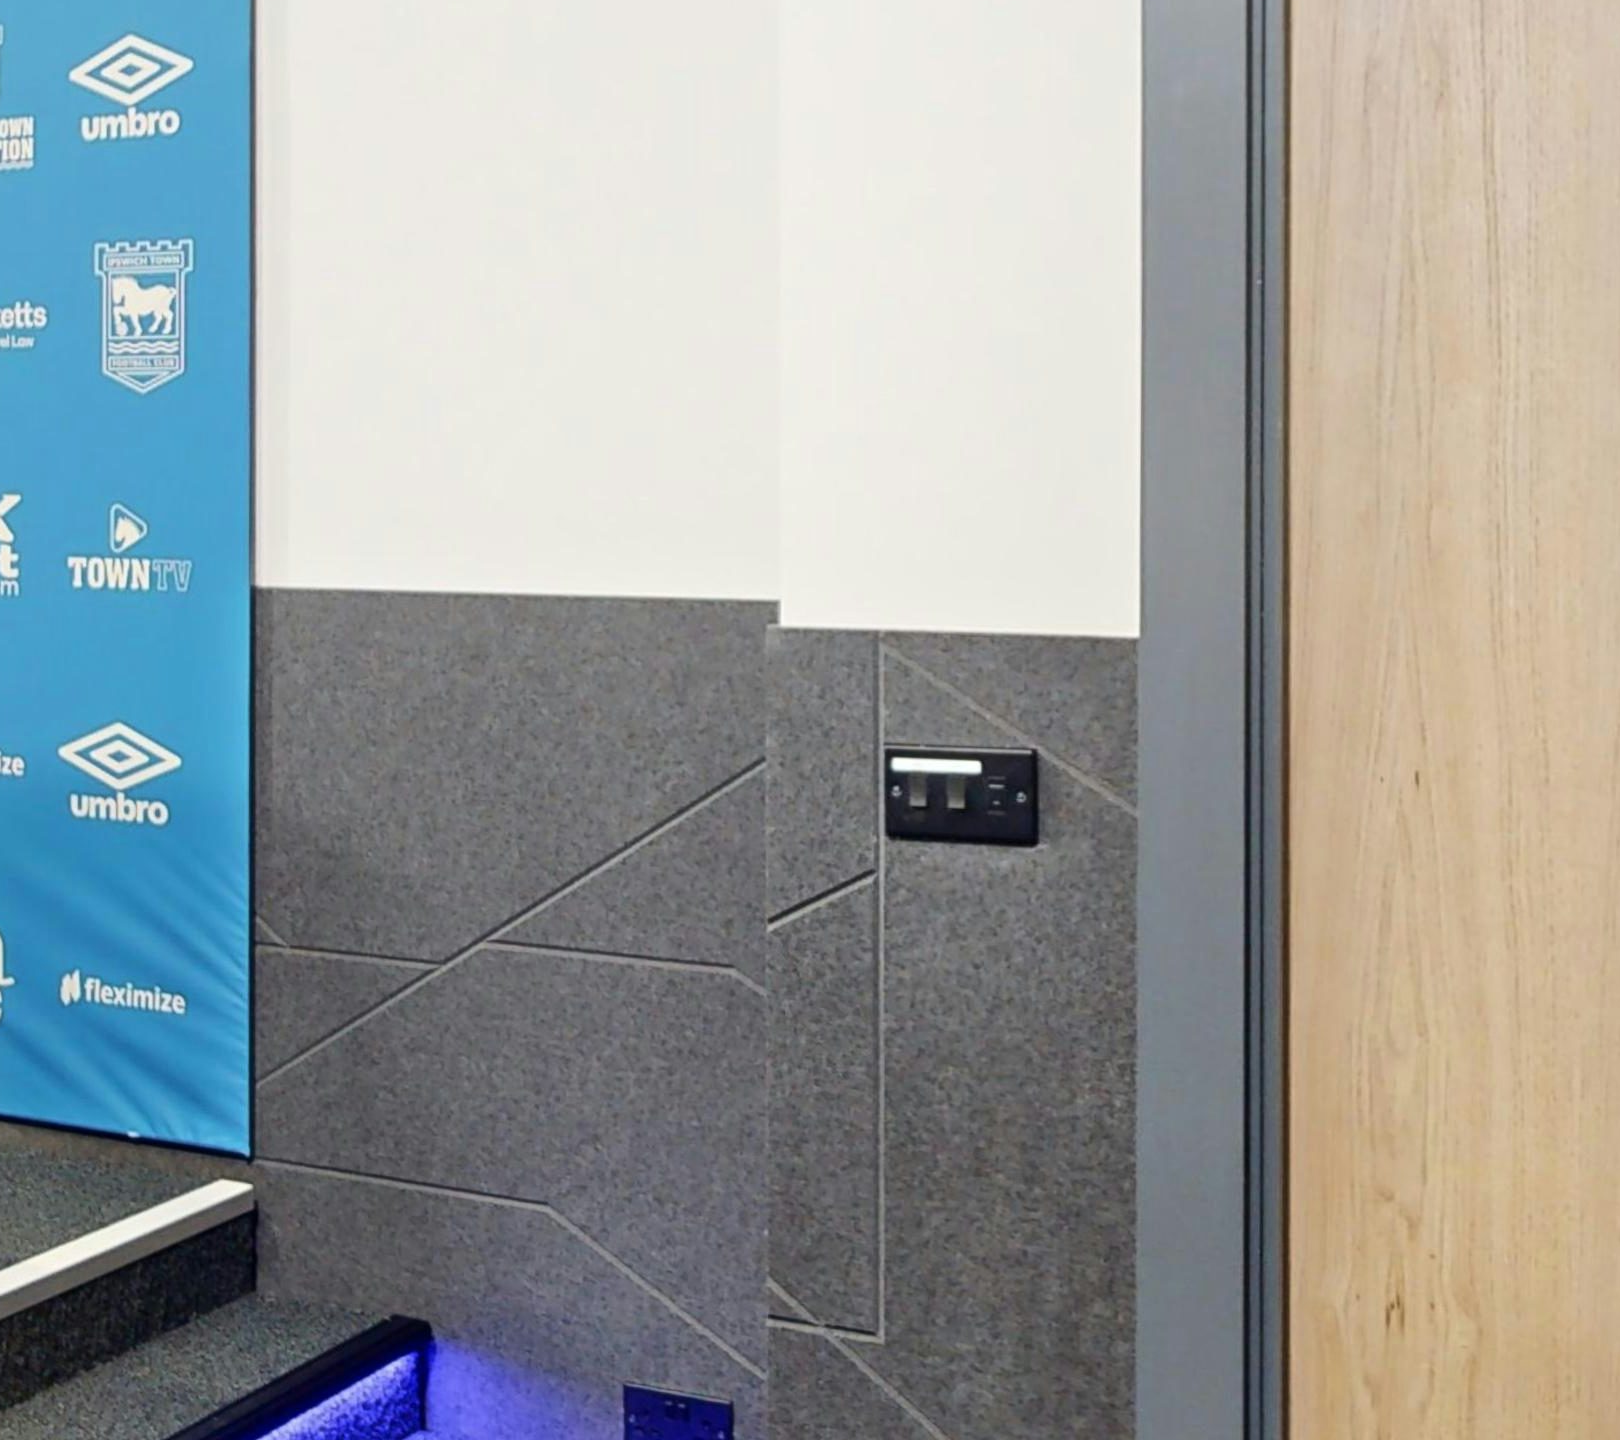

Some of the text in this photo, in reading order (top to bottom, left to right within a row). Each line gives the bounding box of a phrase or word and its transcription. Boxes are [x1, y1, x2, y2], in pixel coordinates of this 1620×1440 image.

[81, 104, 180, 140] umbro
[70, 789, 168, 825] umbro
[84, 978, 185, 1014] fleximize
